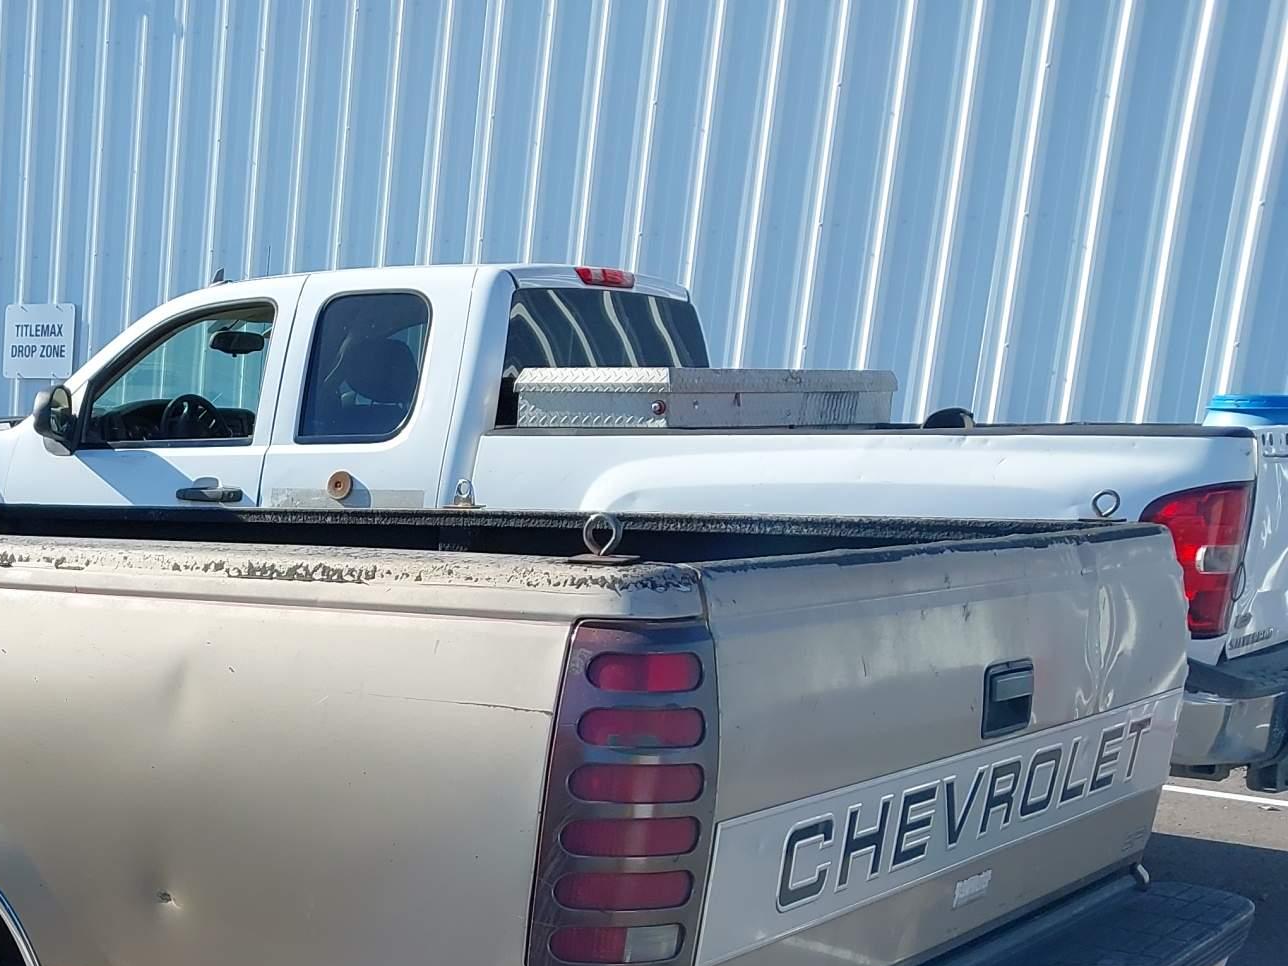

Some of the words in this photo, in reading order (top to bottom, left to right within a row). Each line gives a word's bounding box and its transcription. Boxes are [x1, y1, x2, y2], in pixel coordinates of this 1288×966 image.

[15, 324, 64, 337] TITLEMAX
[11, 344, 37, 358] DROP
[40, 344, 66, 358] ZONE
[776, 716, 1153, 913] CHEVROLET
